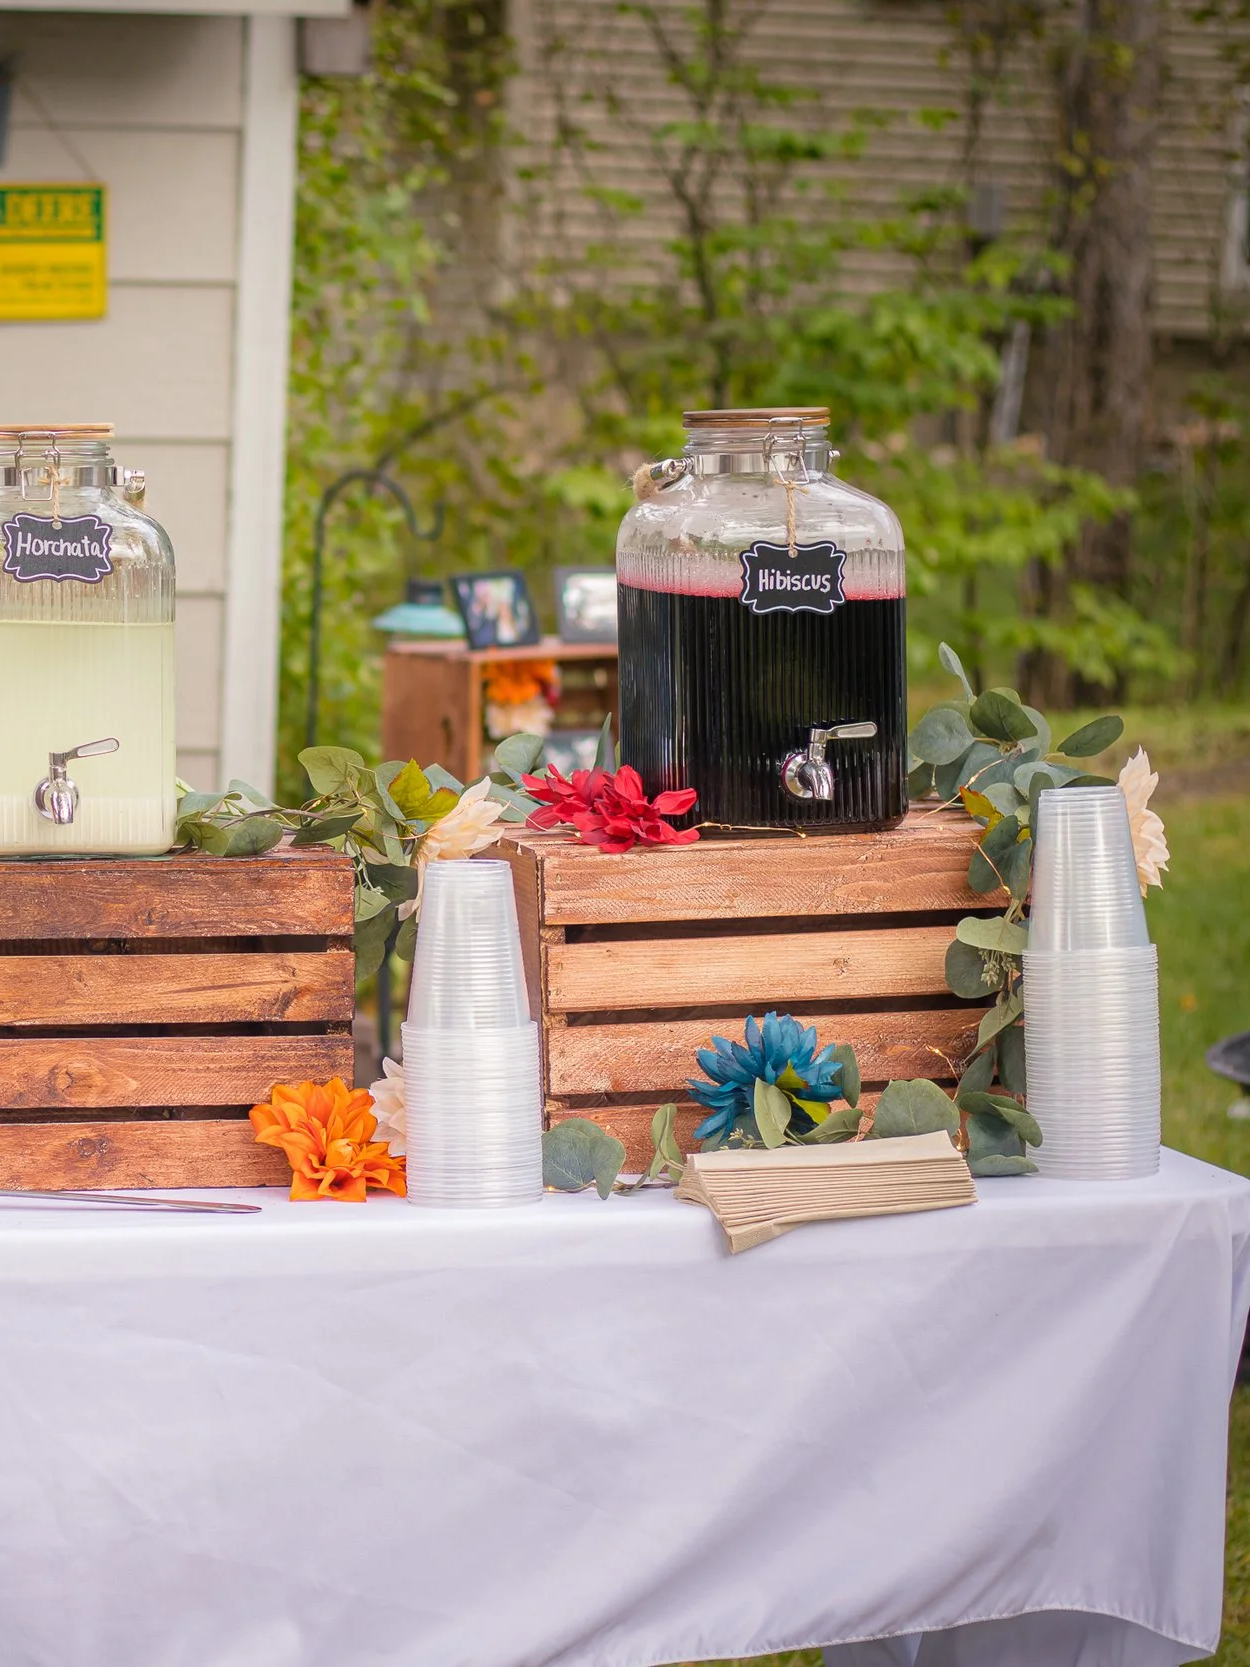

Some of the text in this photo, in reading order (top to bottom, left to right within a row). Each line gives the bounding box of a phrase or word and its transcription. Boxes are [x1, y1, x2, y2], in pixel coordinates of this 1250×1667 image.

[5, 192, 95, 224] DEERE
[16, 531, 104, 558] Horchata
[758, 568, 831, 593] Hibiscus
